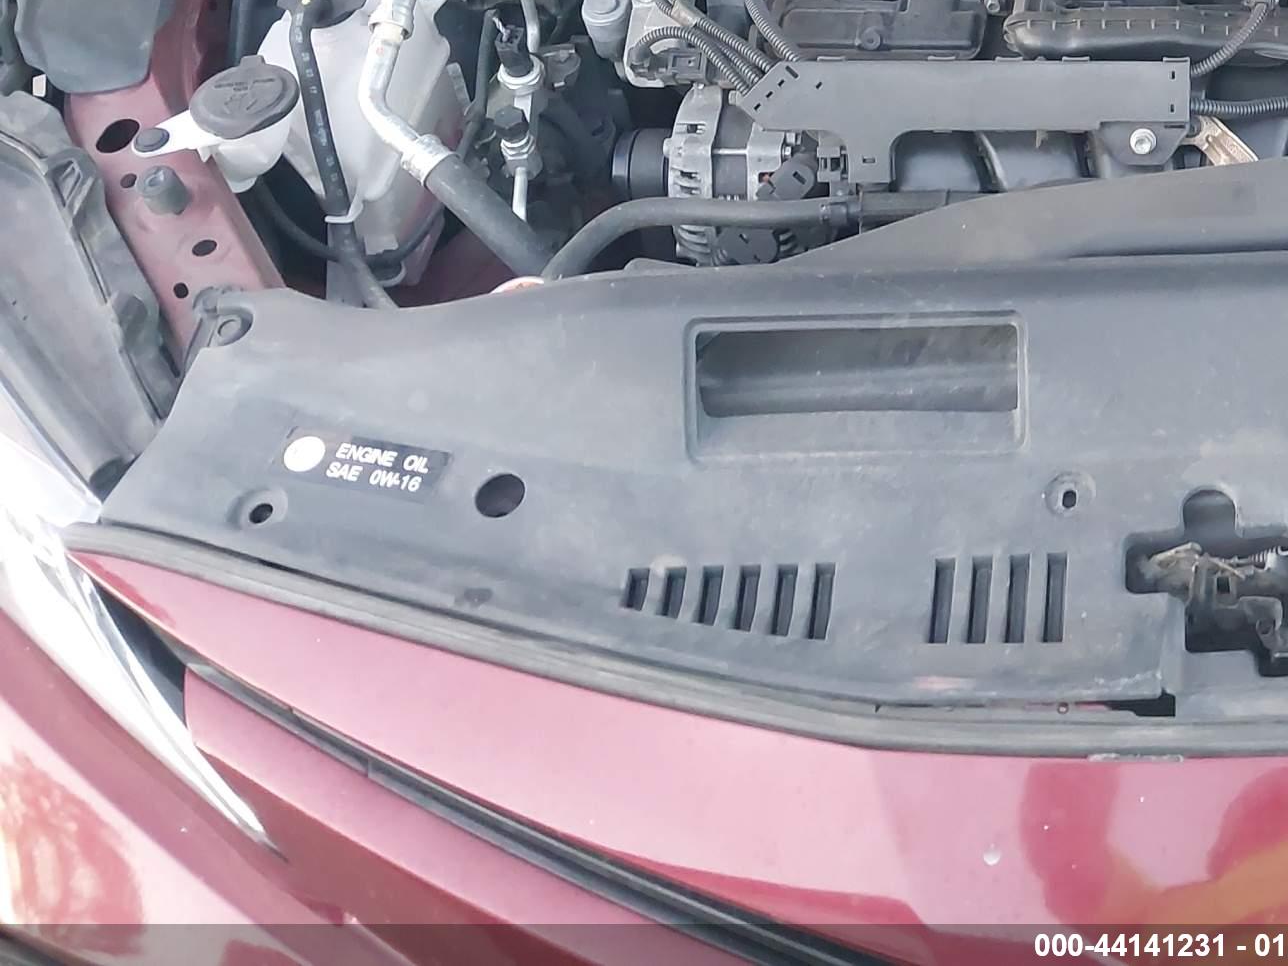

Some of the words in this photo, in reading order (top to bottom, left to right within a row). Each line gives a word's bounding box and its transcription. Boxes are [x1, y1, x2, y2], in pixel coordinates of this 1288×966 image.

[336, 442, 398, 467] ENGINE
[403, 455, 429, 474] OIL
[326, 462, 363, 482] SAE
[369, 469, 422, 492] 0W-16
